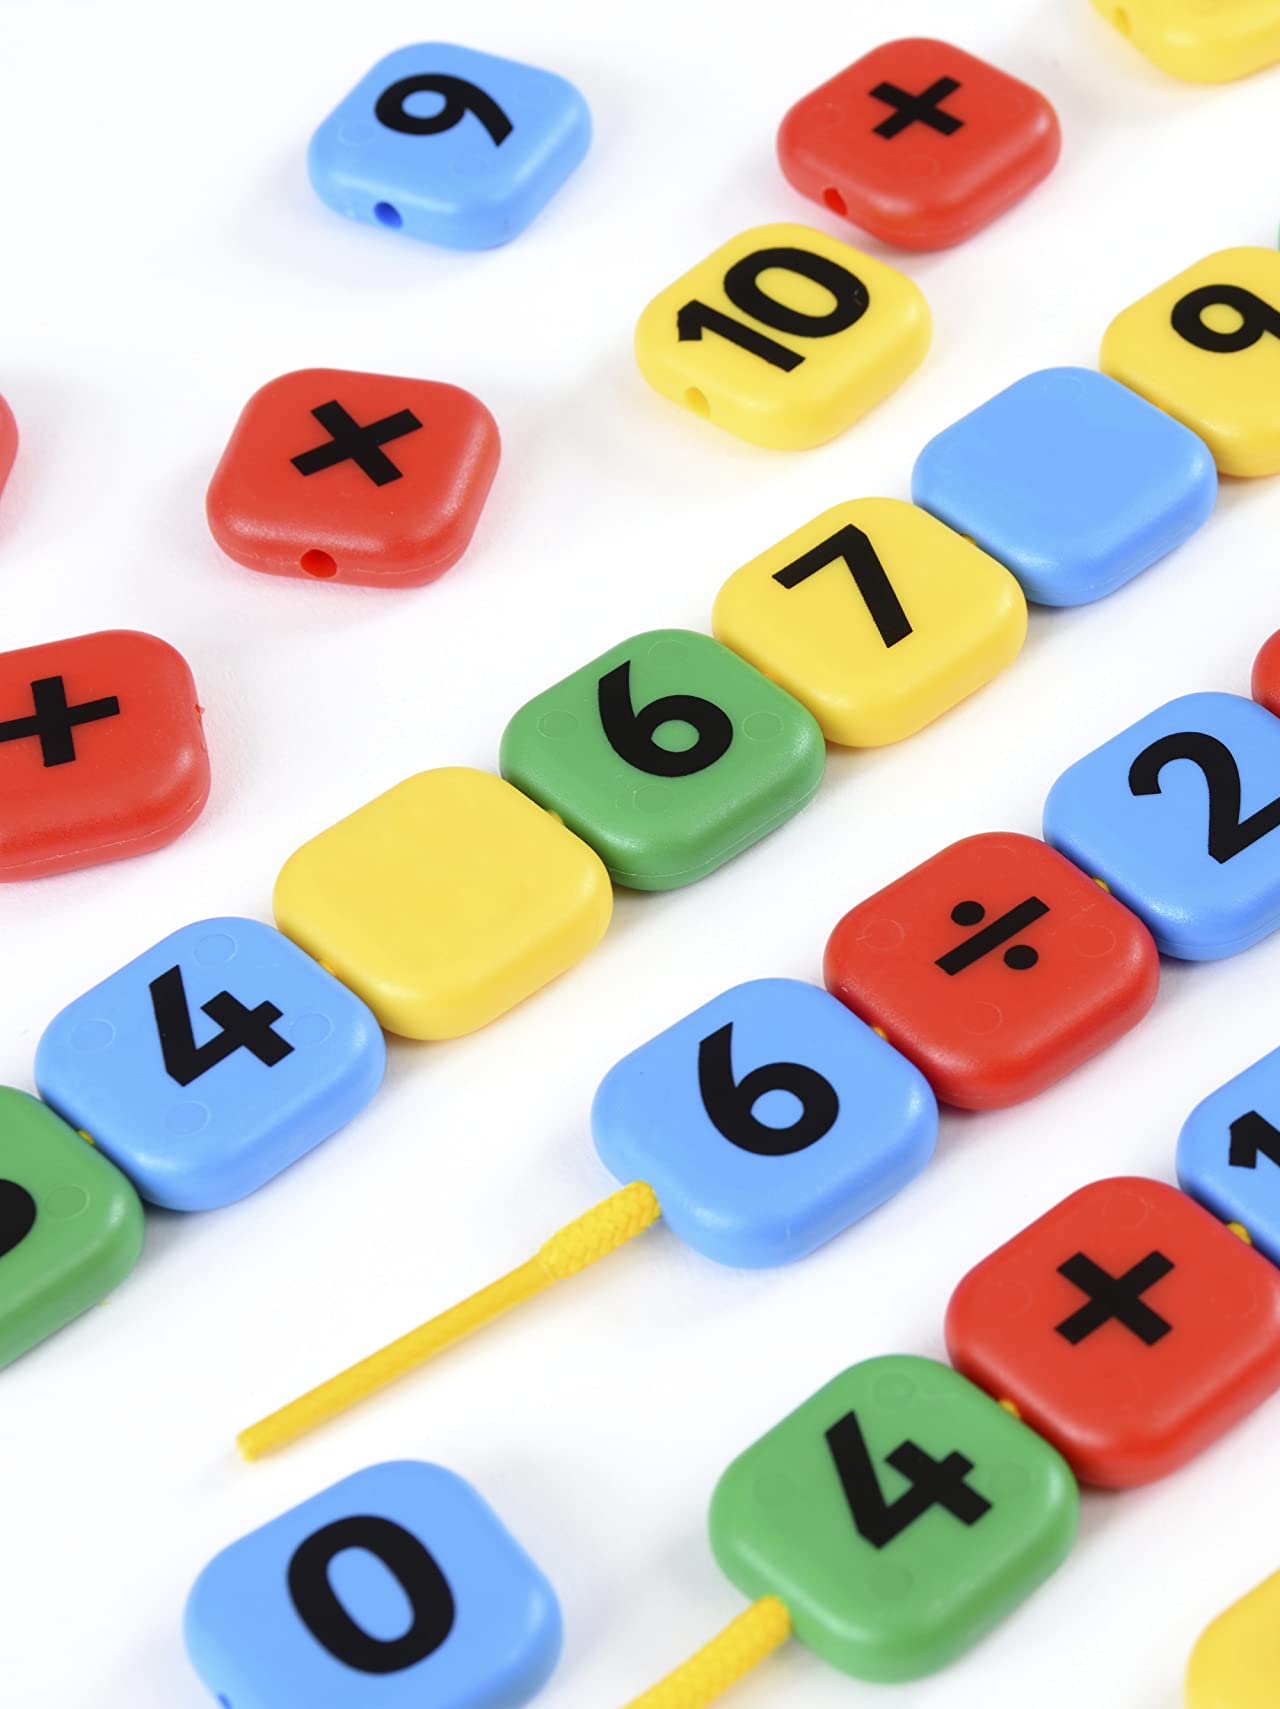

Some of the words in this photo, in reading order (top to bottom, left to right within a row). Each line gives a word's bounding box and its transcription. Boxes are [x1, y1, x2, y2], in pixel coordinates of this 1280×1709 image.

[677, 248, 870, 373] 10
[149, 965, 294, 1087] 4
[597, 659, 734, 779] 6
[771, 523, 913, 649] 7
[698, 1022, 839, 1156] 6
[824, 1410, 993, 1550] 4
[288, 1516, 454, 1674] 0
